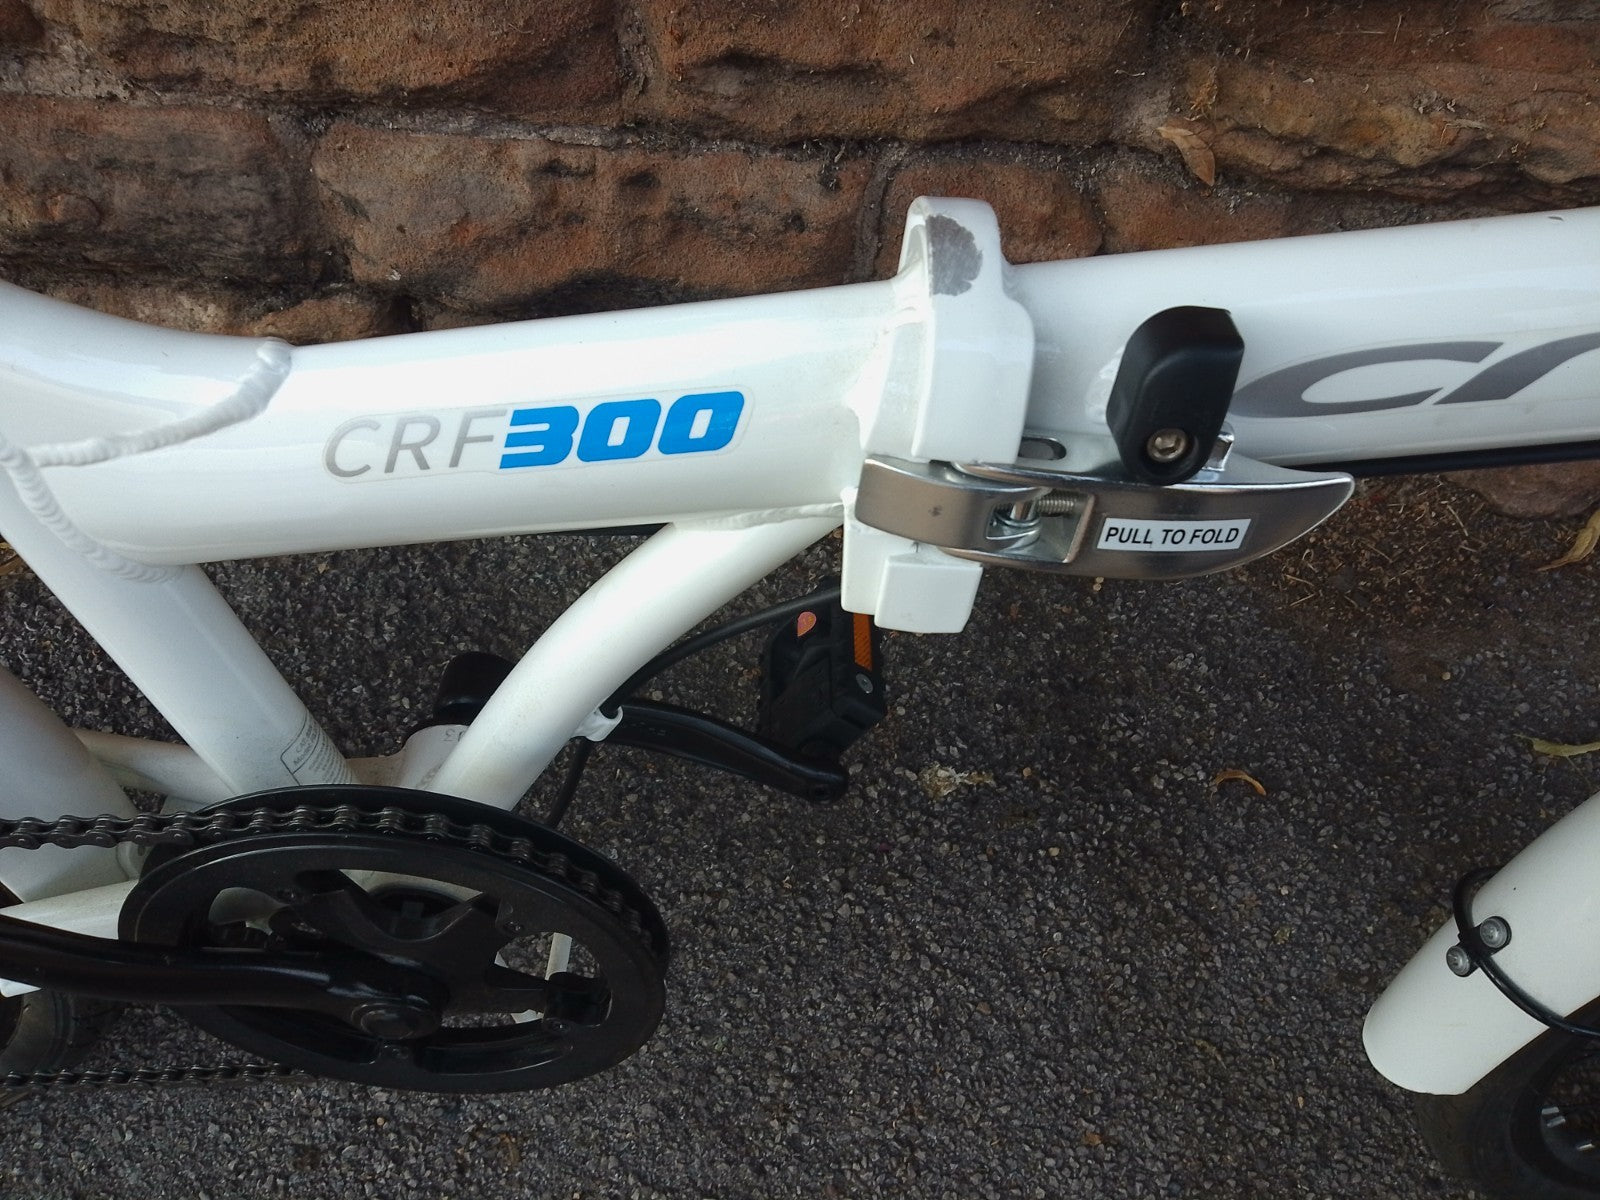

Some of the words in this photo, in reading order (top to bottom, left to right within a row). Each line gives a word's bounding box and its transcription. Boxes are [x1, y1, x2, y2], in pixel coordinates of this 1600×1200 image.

[1105, 527, 1152, 544] PULL
[1161, 530, 1186, 545] TO
[1188, 528, 1240, 545] FOLD
